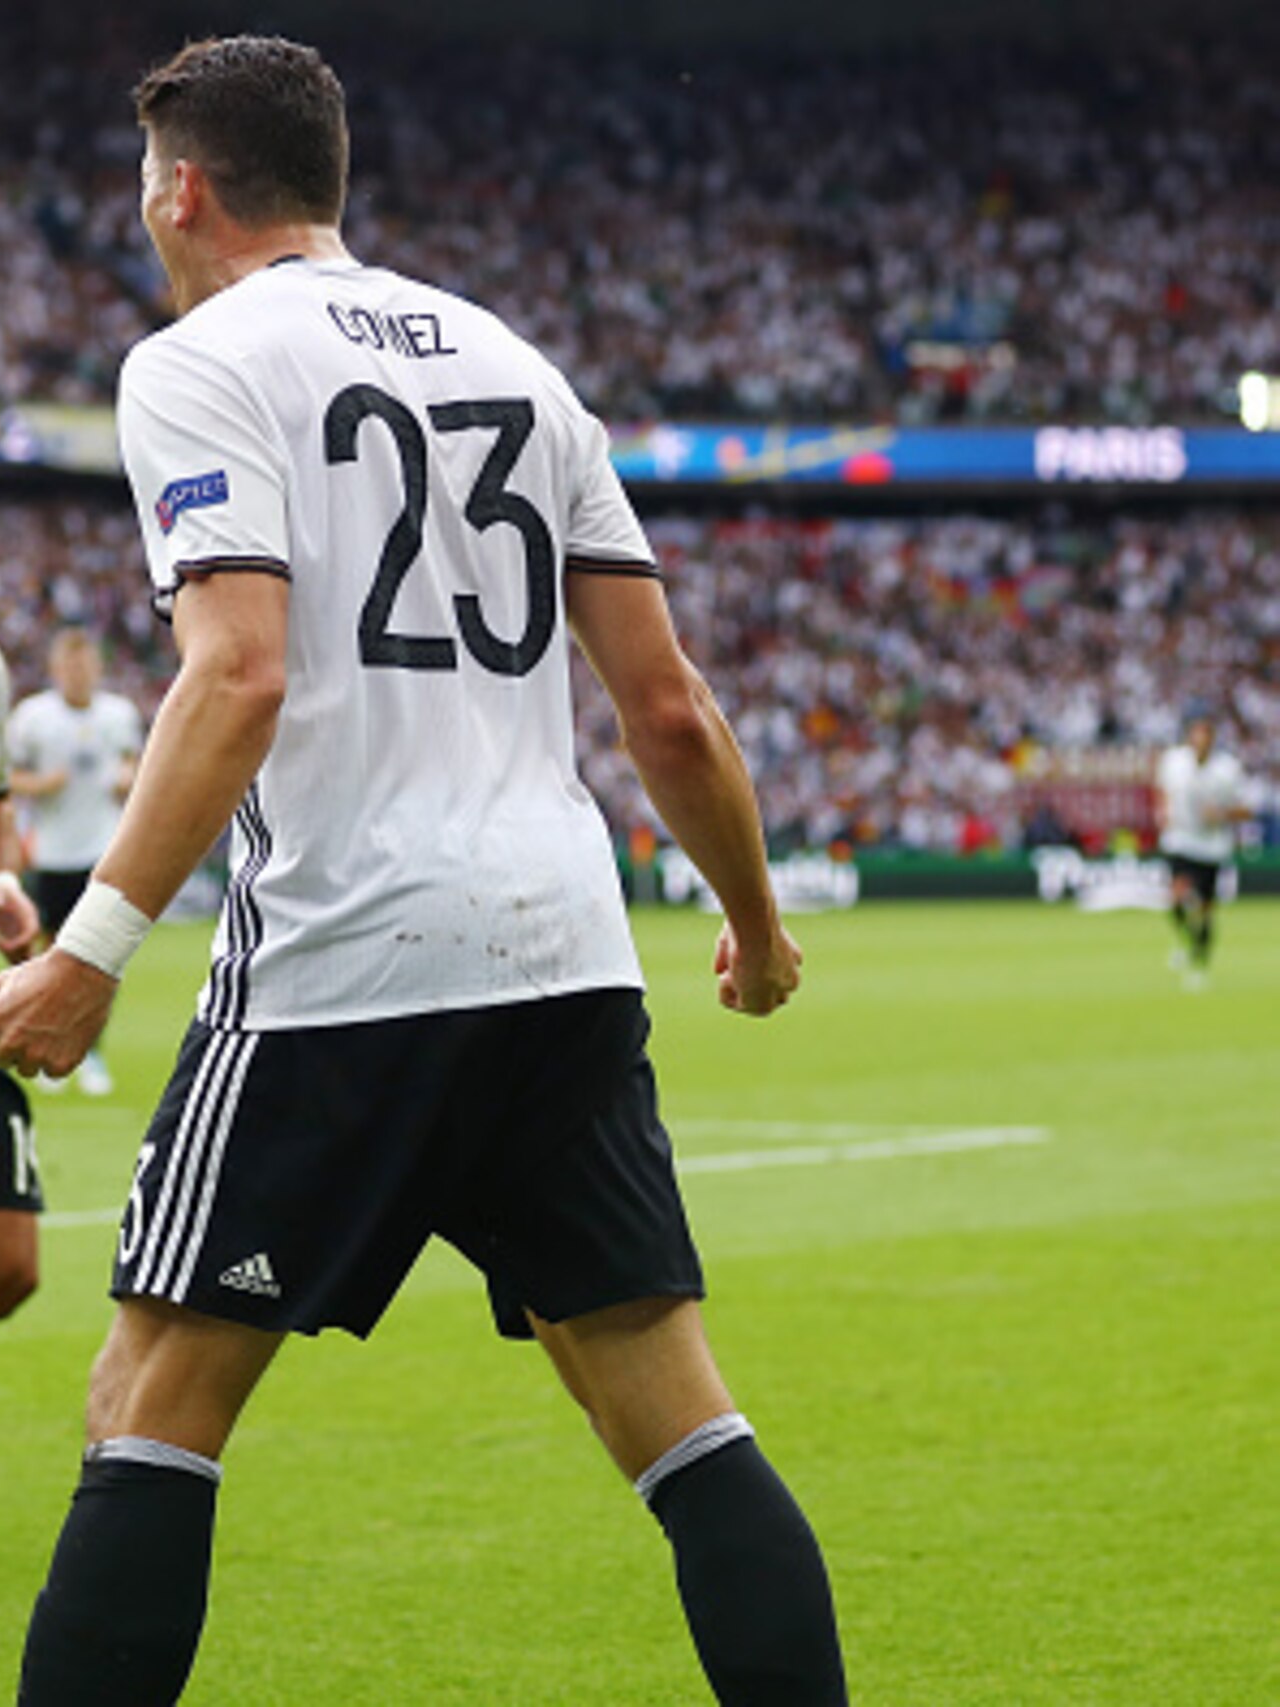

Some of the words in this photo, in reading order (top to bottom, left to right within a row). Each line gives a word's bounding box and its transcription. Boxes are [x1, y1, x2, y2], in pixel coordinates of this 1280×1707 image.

[327, 302, 457, 357] GOMEZ
[1034, 426, 1187, 481] PARIS
[324, 383, 556, 676] 23
